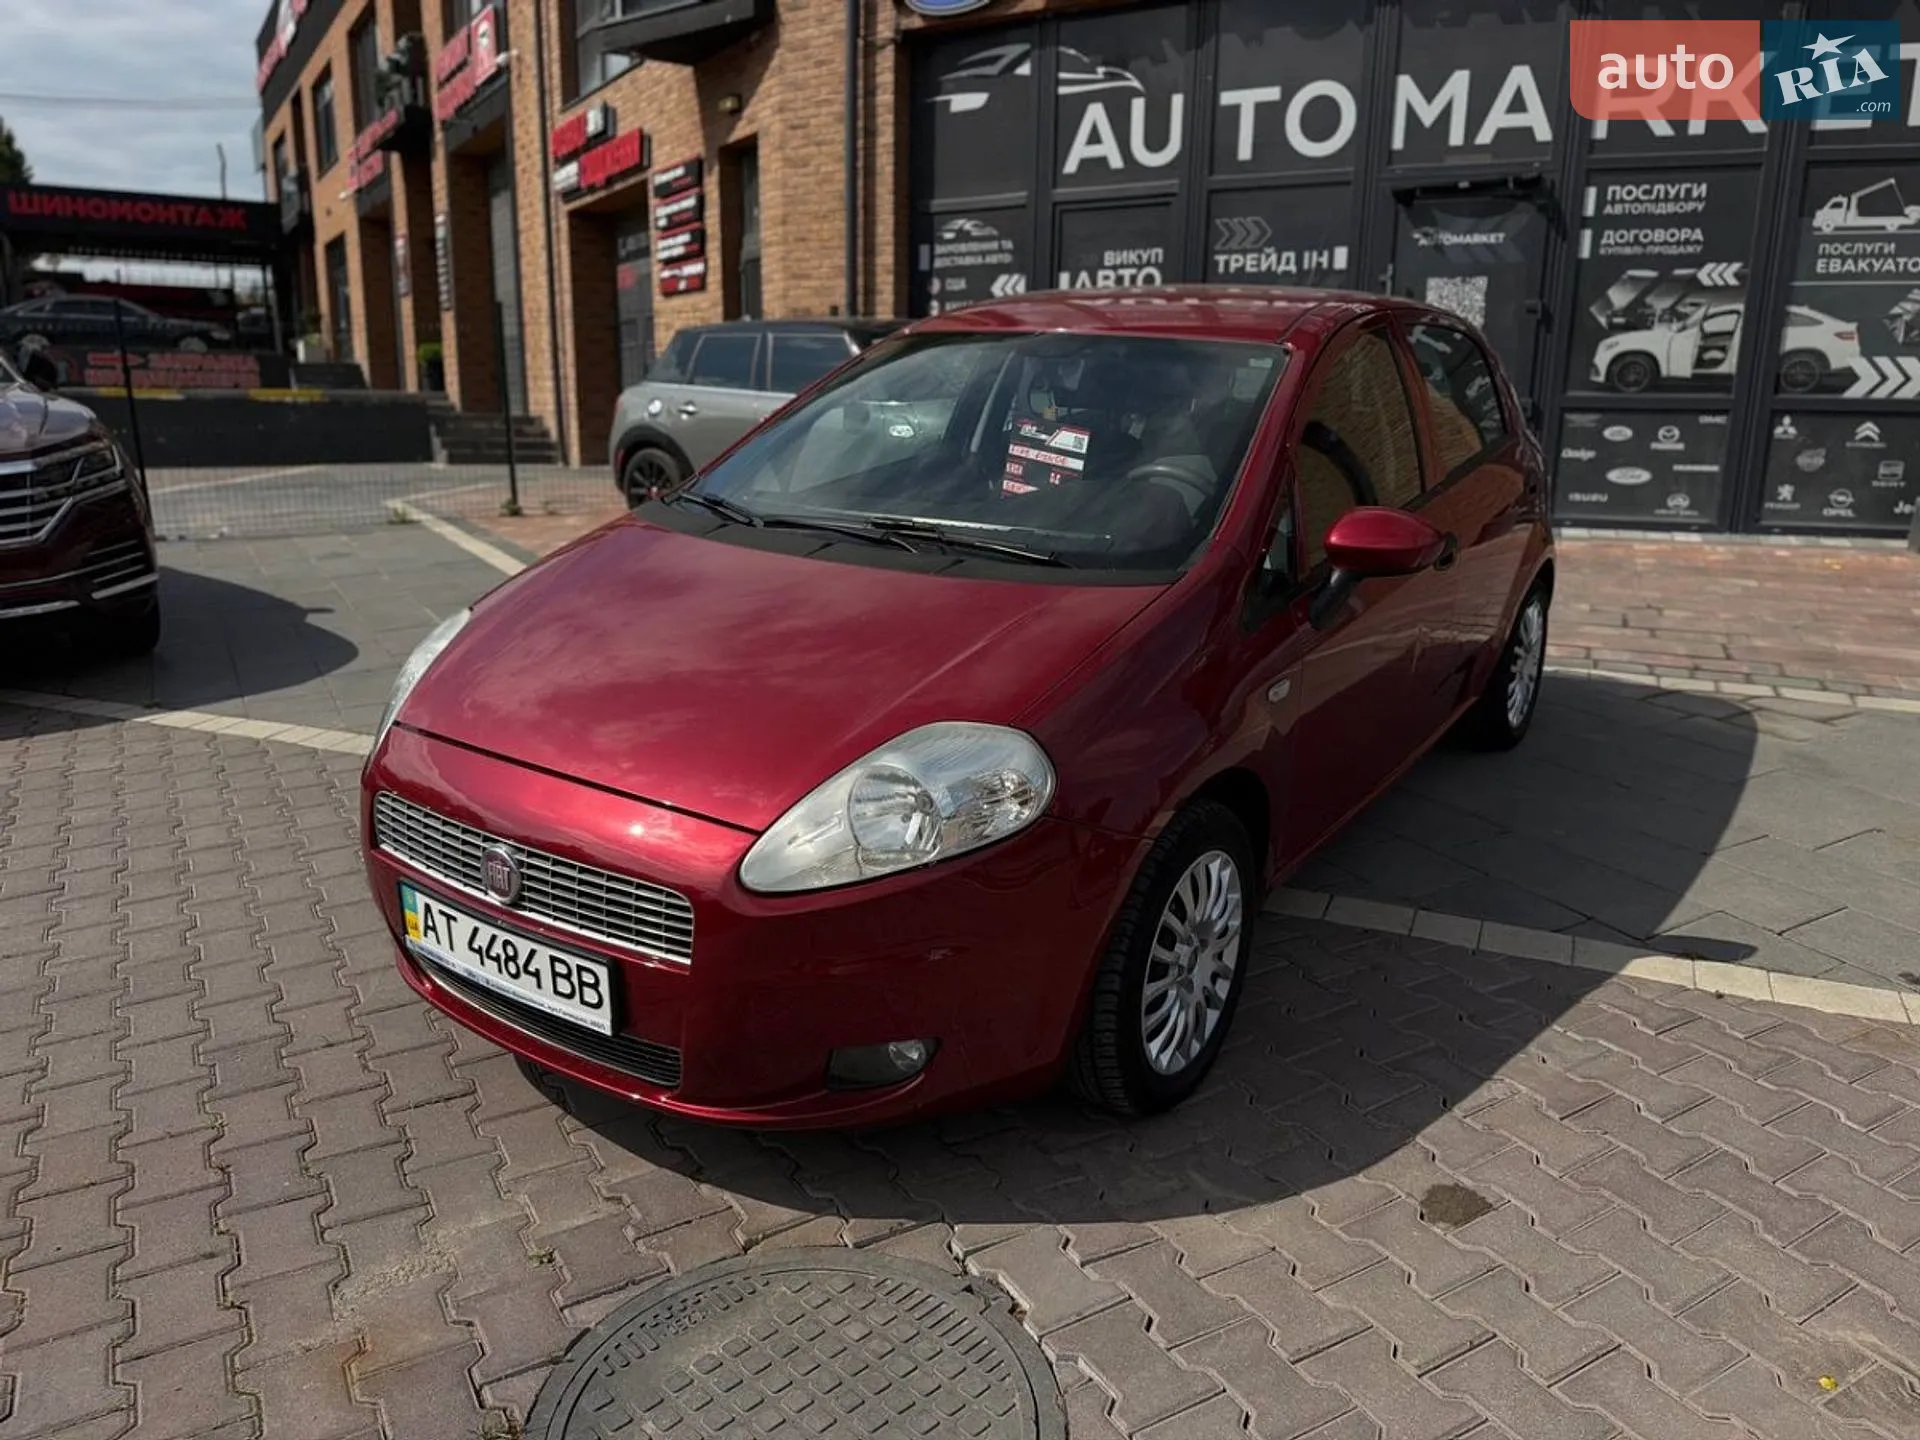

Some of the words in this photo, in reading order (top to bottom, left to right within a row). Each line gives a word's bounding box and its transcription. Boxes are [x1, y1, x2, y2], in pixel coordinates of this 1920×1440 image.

[1606, 182, 1707, 201] ПОСЛУГИ
[8, 191, 247, 230] ШИНОМОНТАЖ
[1603, 201, 1706, 215] АВТОПІДБОРУ
[1601, 228, 1704, 245] ДОГОВОРА
[1103, 248, 1164, 266] ВИКУП
[1818, 241, 1896, 256] ПОСЛУГИ
[1214, 247, 1297, 274] ТРЕЙД
[424, 902, 458, 951] AT
[467, 925, 543, 990] 4484
[549, 953, 605, 1010] BB
